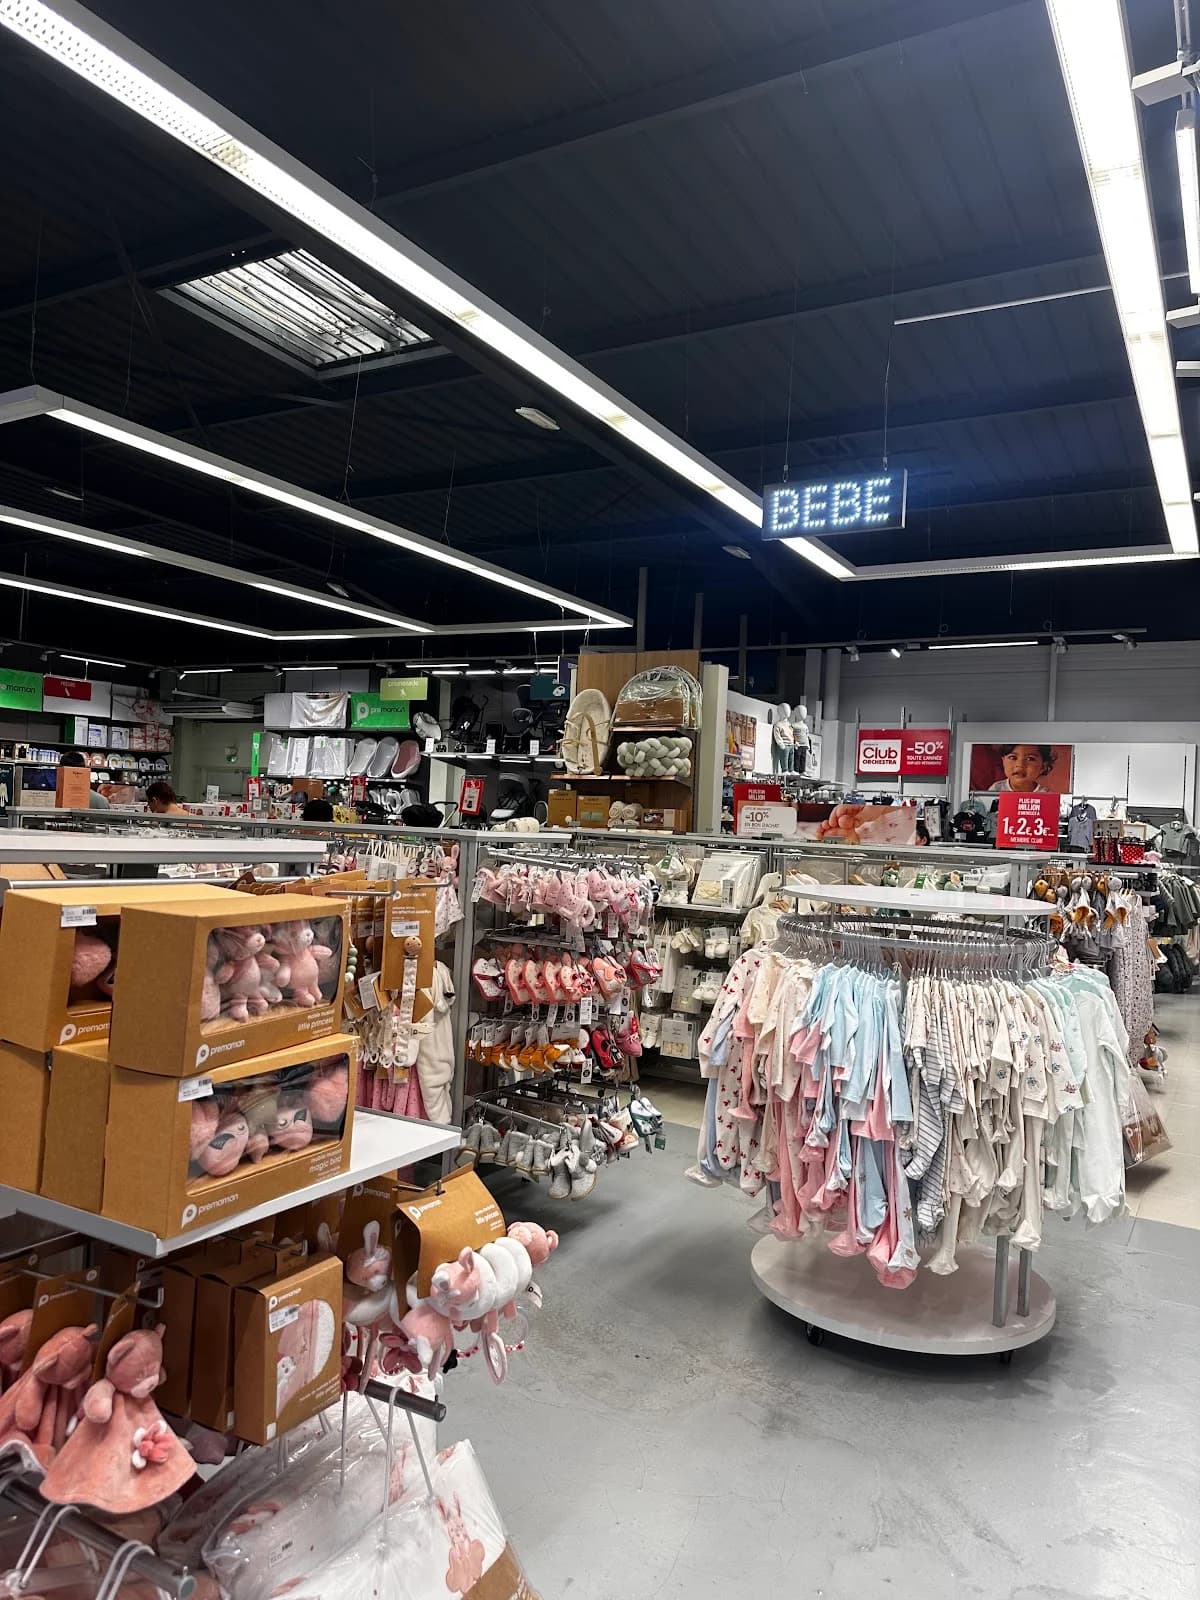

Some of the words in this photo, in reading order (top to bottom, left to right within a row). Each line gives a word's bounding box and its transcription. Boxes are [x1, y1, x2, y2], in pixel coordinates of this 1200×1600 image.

[772, 477, 892, 531] BEBE
[863, 747, 898, 759] Club
[906, 741, 944, 754] -50%
[1017, 803, 1041, 811] MILLION
[745, 811, 769, 822] -10%
[77, 1022, 111, 1036] premam
[210, 1039, 246, 1056] premaman
[198, 1193, 240, 1216] premaman
